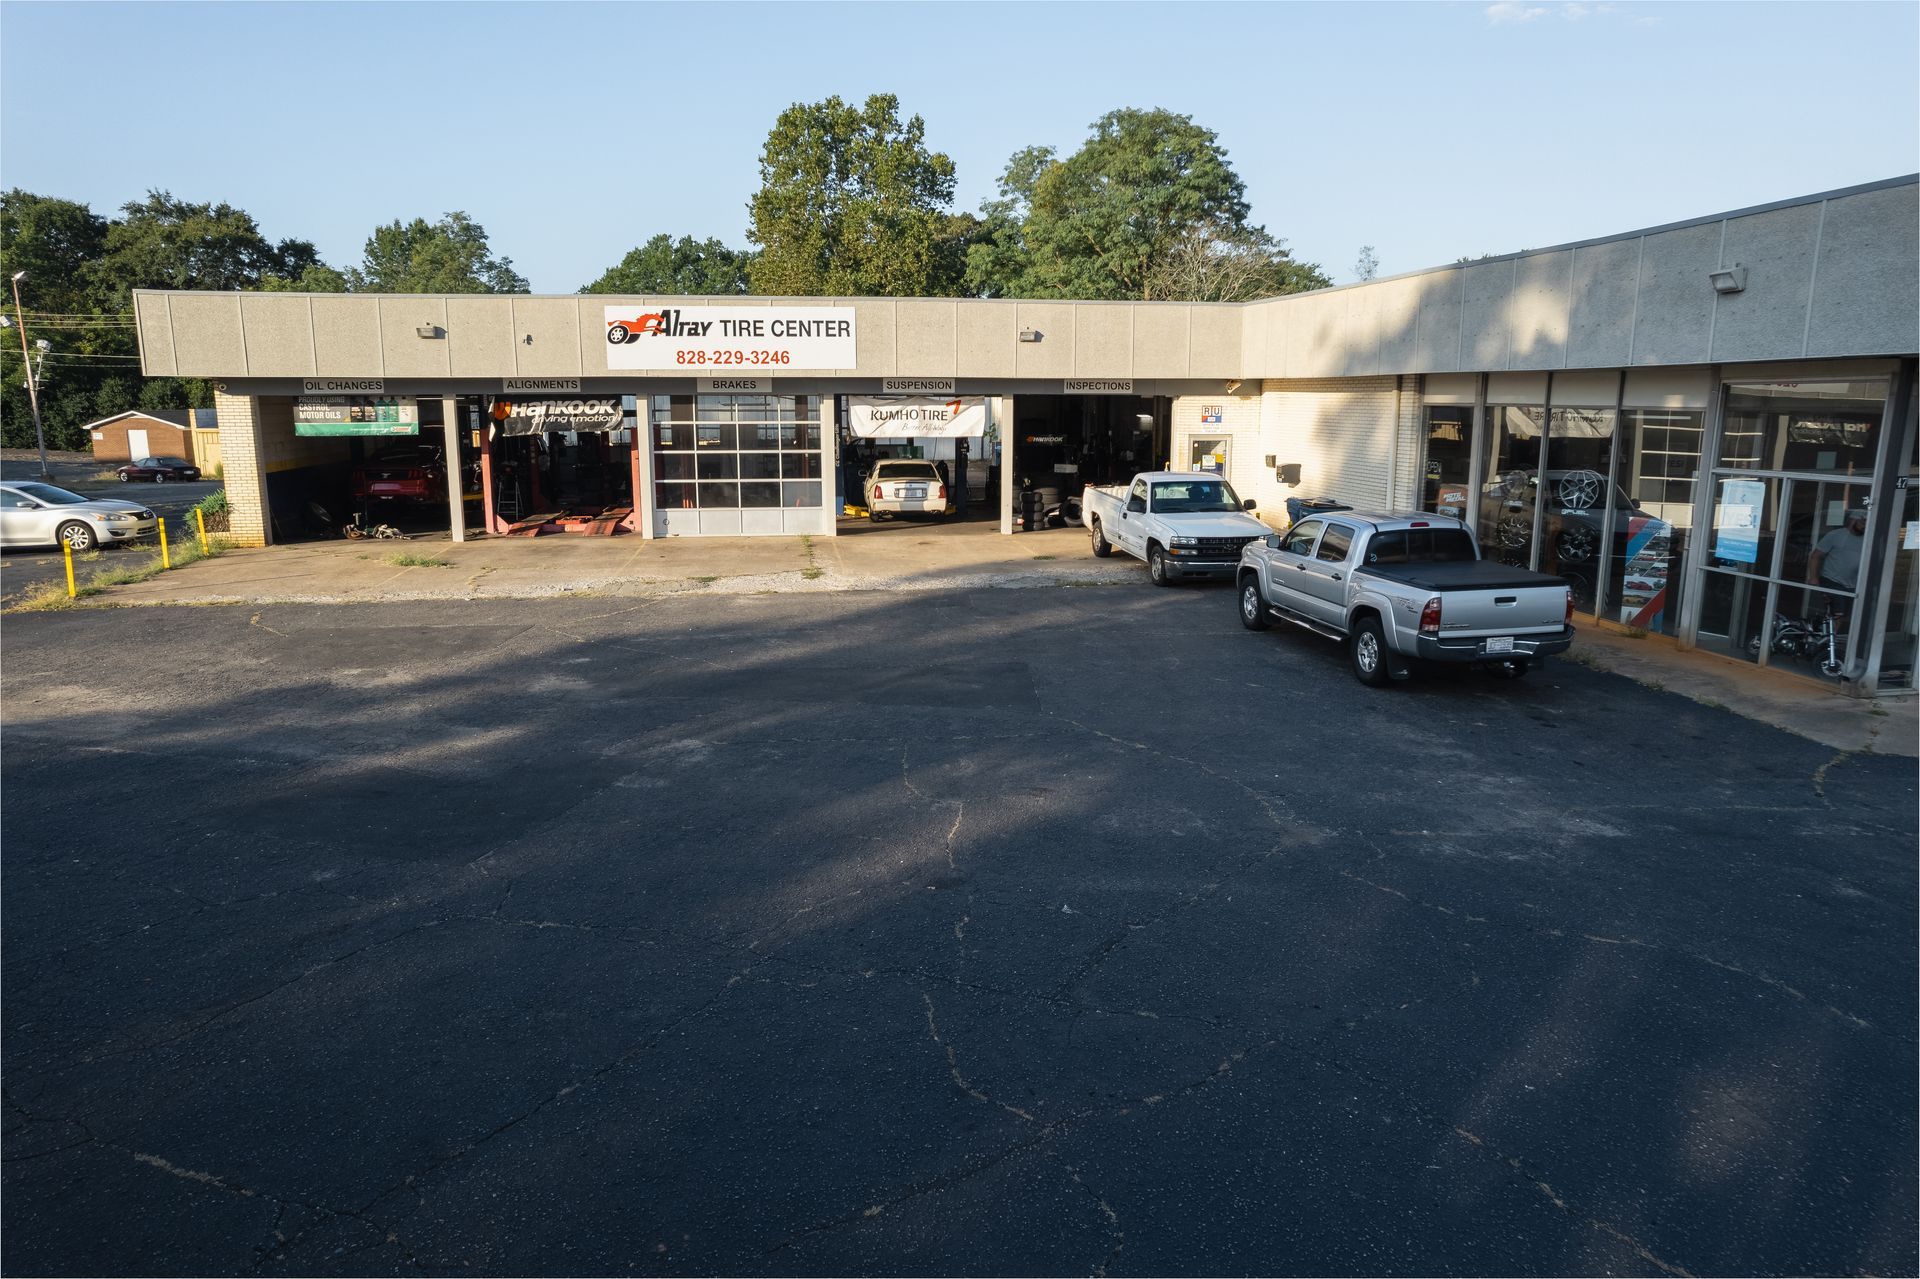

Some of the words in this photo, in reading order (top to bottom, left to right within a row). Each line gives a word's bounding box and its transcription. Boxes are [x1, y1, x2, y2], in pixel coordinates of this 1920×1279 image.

[652, 309, 713, 337] Alray
[719, 319, 764, 337] TIRE
[771, 319, 851, 338] CENTER
[676, 350, 790, 365] 828-229-3246
[305, 381, 324, 391] OIL
[327, 381, 383, 390] CHANGES
[506, 380, 578, 389] ALIGNMENTS
[712, 380, 757, 389] BRAKES
[886, 381, 952, 389] SUSPENSION
[1066, 381, 1131, 390] INSPECTIONS
[298, 403, 331, 411] CASTROL
[299, 411, 326, 419] MOTOR
[326, 411, 341, 419] OILS
[531, 414, 568, 424] driving
[569, 414, 615, 422] emotion
[870, 409, 919, 421] KUMHO
[920, 409, 949, 421] TIRE
[1897, 478, 1907, 488] 47
